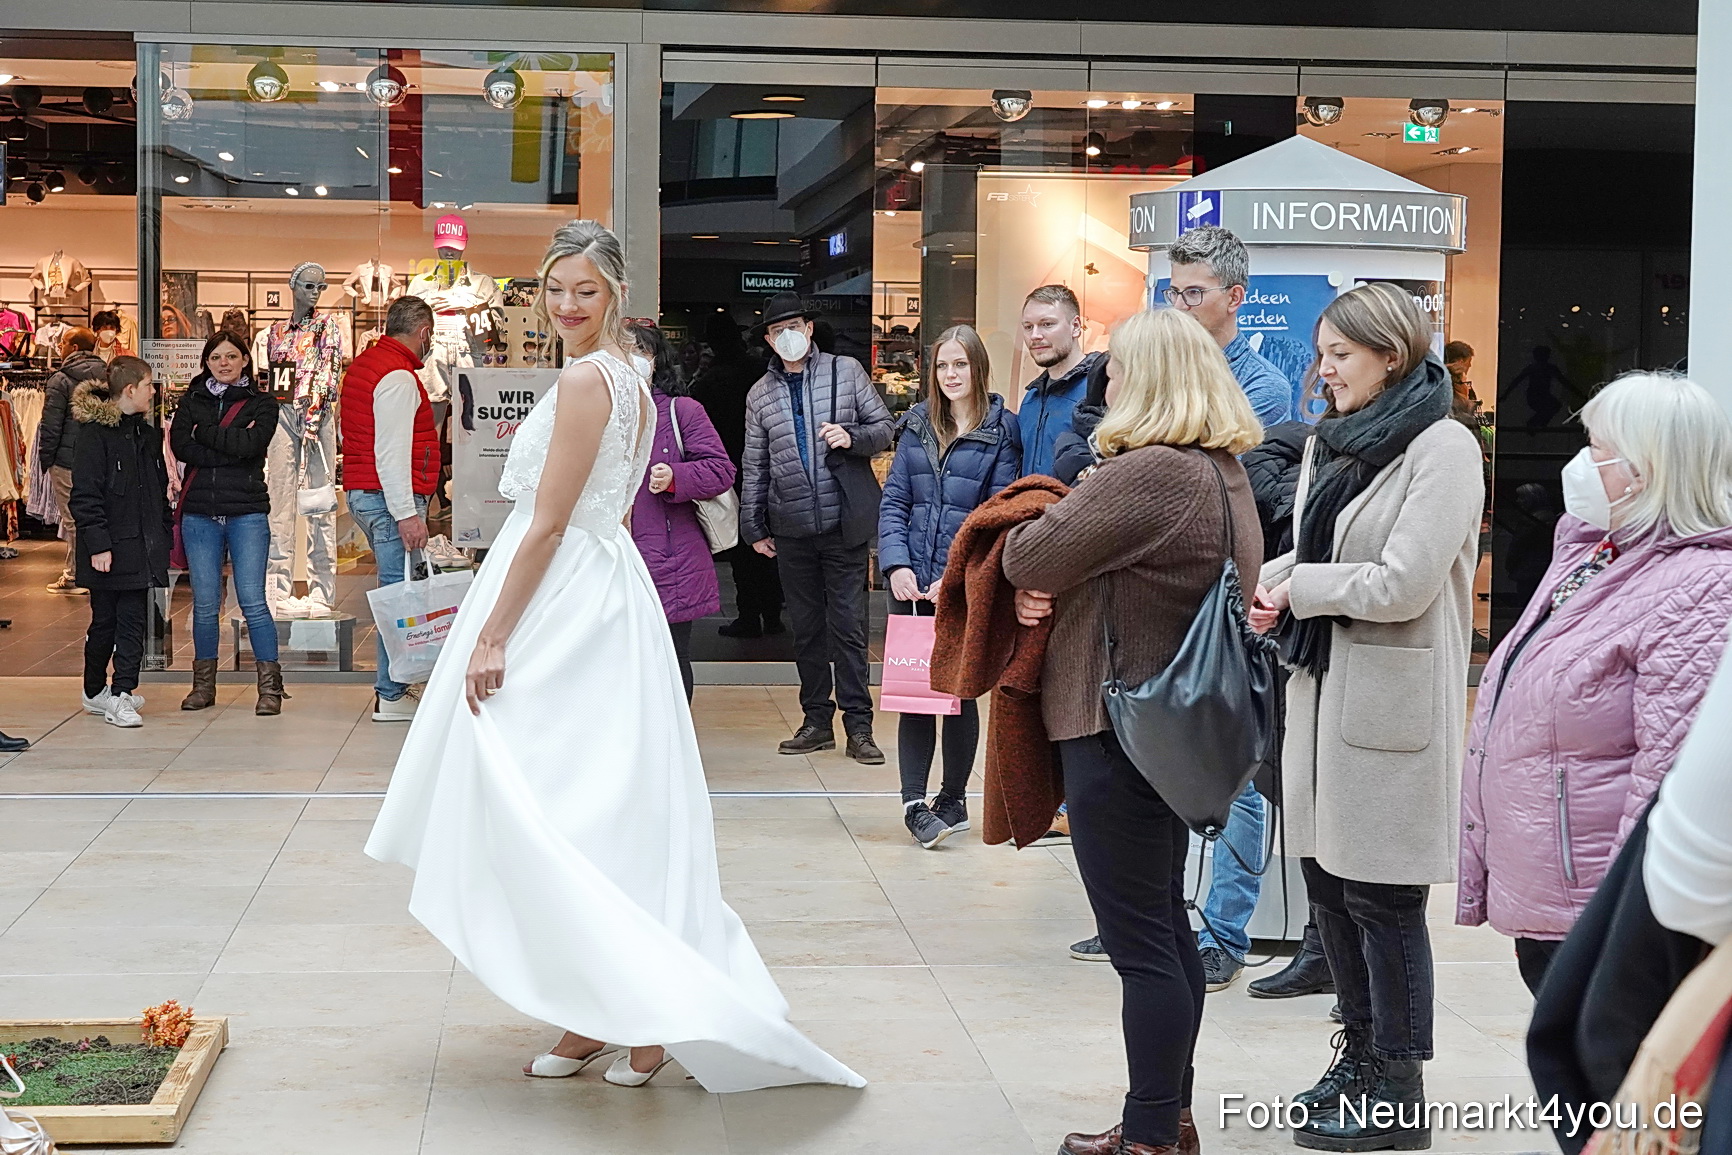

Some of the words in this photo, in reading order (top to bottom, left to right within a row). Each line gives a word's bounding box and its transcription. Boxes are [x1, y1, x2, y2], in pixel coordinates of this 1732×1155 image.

[1252, 201, 1456, 236] INFORMATION
[437, 222, 464, 237] ICONO
[1241, 288, 1291, 305] Ideen
[469, 309, 492, 336] 24
[1236, 308, 1288, 325] erden
[145, 352, 169, 360] Montag
[273, 367, 291, 391] 14
[498, 390, 535, 404] WIR
[477, 406, 534, 420] SUCH
[434, 621, 452, 633] famil
[888, 656, 917, 667] NAF
[919, 659, 931, 668] N
